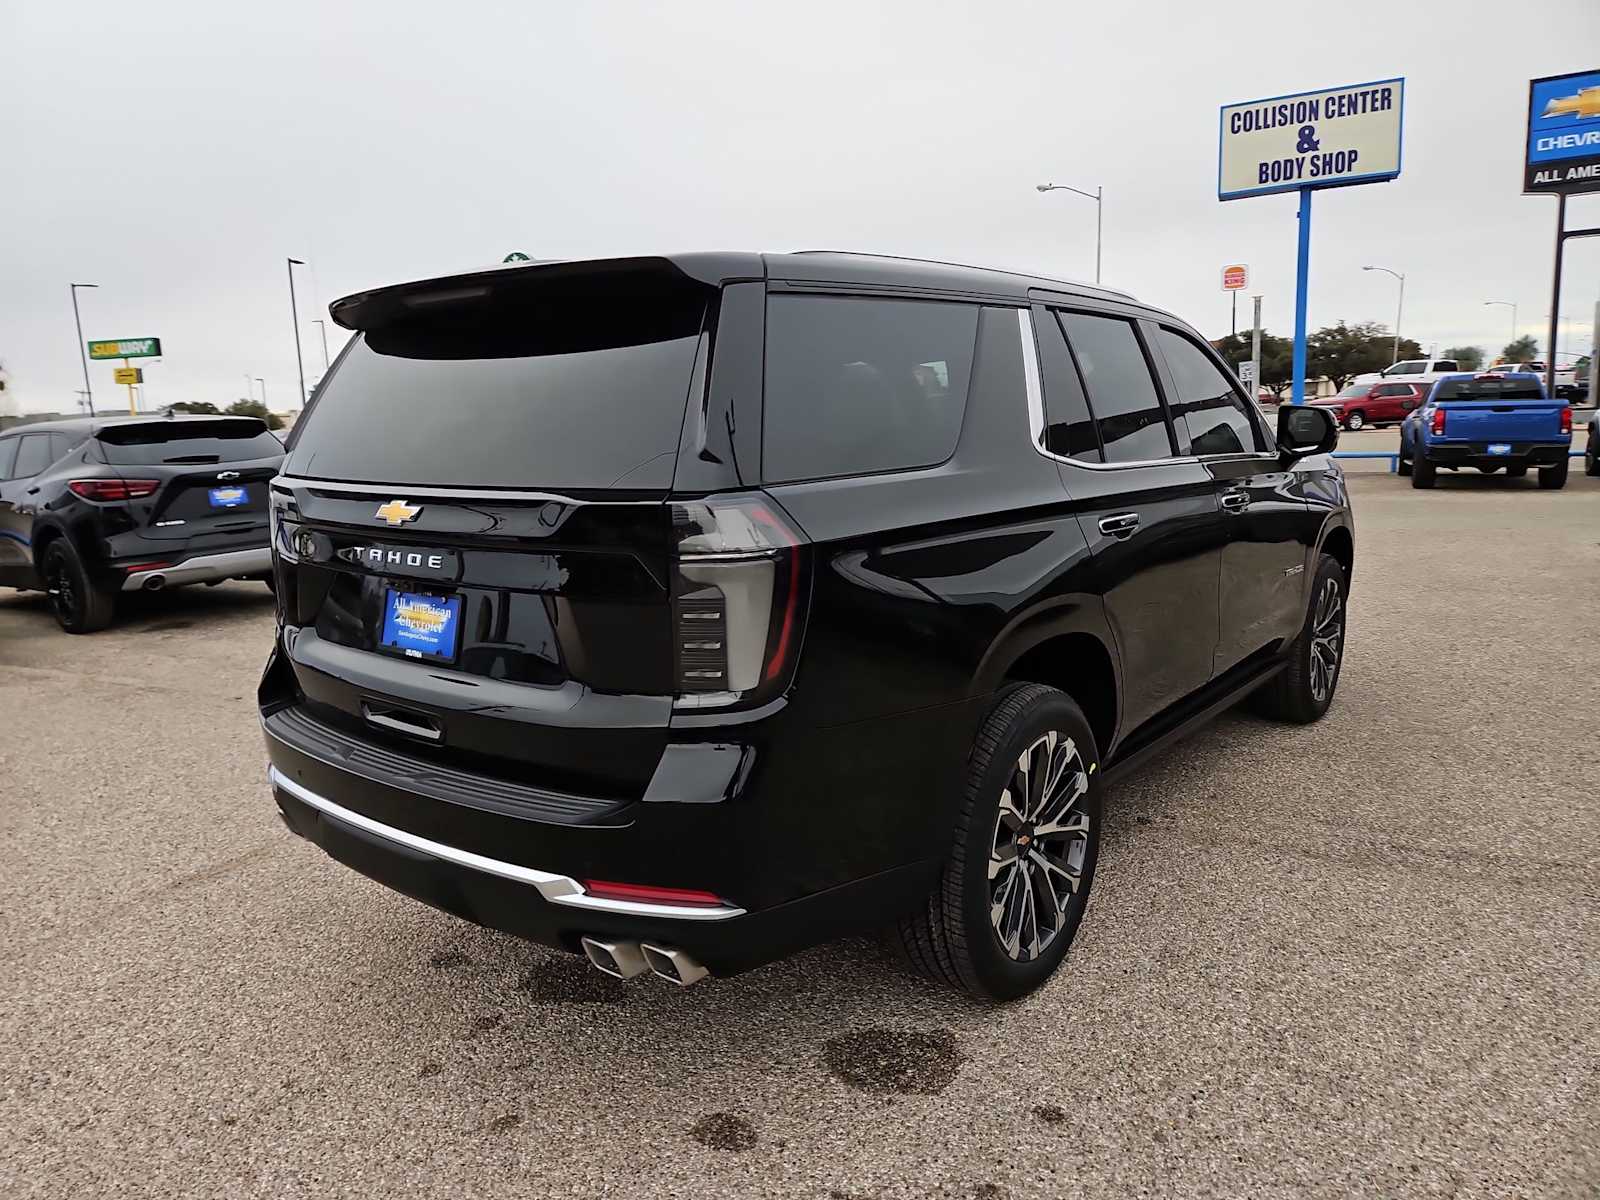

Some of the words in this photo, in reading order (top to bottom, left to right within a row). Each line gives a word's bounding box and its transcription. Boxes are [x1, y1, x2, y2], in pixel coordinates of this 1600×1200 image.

[1231, 99, 1320, 135] COLLISION
[1324, 87, 1392, 119] CENTER
[1296, 125, 1320, 153] &
[1258, 157, 1306, 184] BODY
[1309, 149, 1358, 177] SHOP
[1533, 169, 1563, 184] ALL
[91, 341, 153, 356] SUBWAY
[353, 546, 442, 568] TAHOE
[393, 597, 407, 609] All
[409, 601, 451, 618] American
